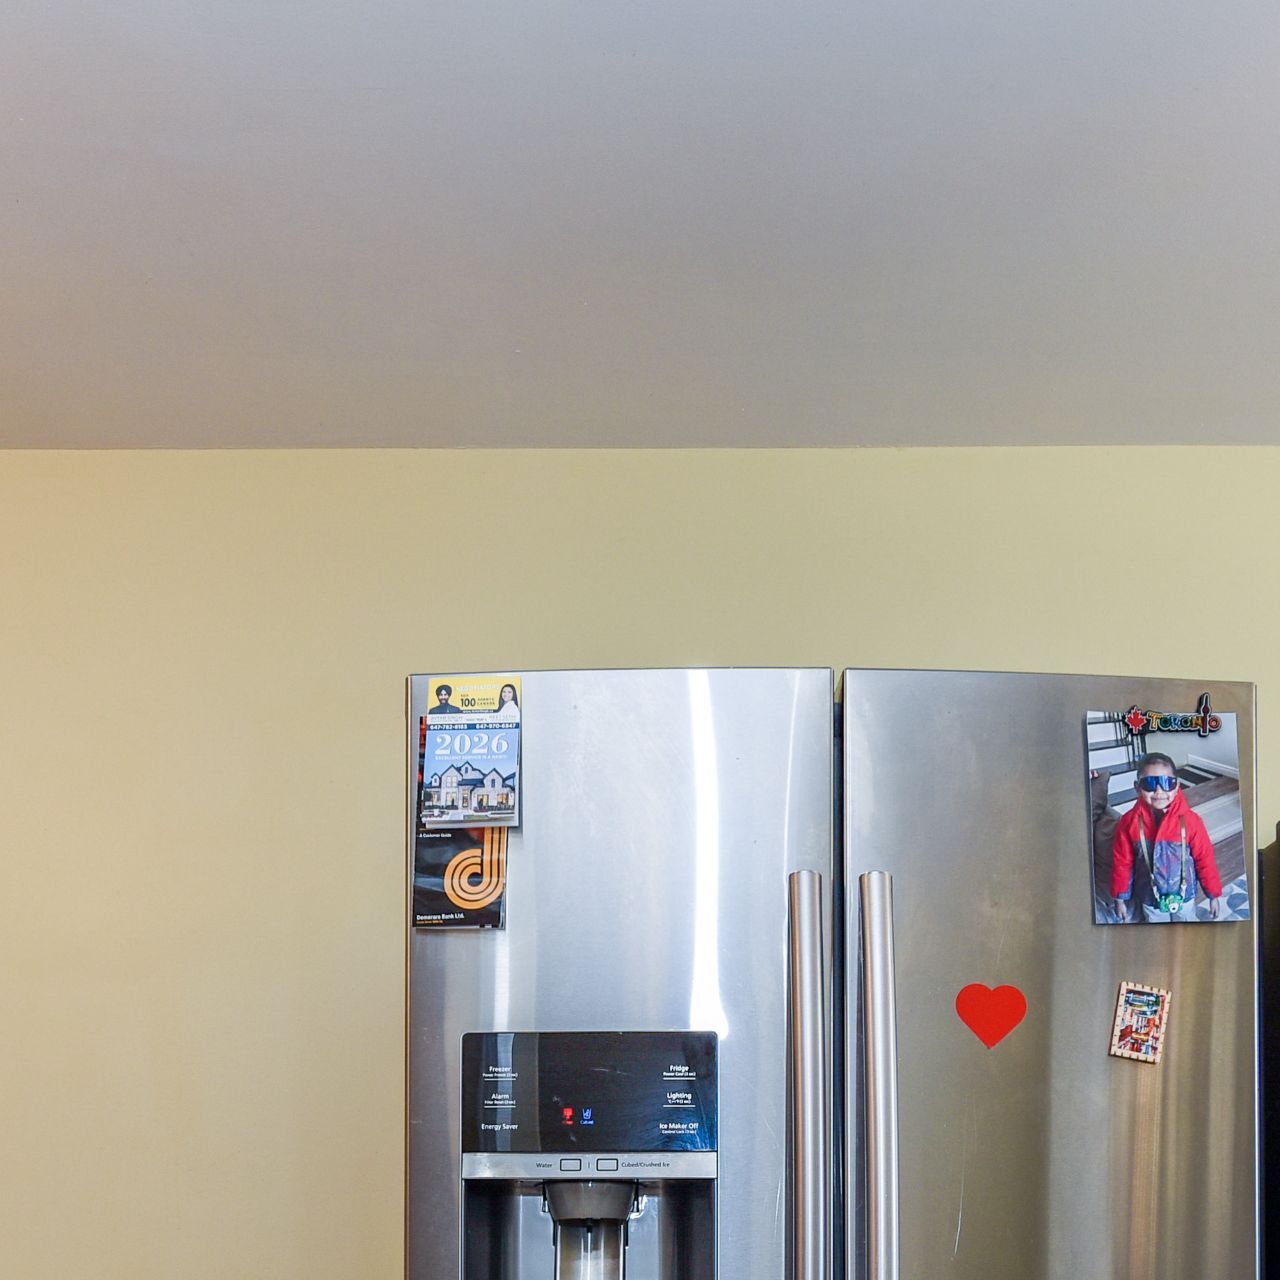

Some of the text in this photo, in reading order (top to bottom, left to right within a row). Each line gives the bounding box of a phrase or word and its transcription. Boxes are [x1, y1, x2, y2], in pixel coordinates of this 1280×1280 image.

[460, 698, 476, 707] 100
[434, 732, 509, 755] 2026
[669, 1065, 690, 1073] Fridge
[666, 1092, 692, 1100] Lighting
[481, 1123, 501, 1131] Energy
